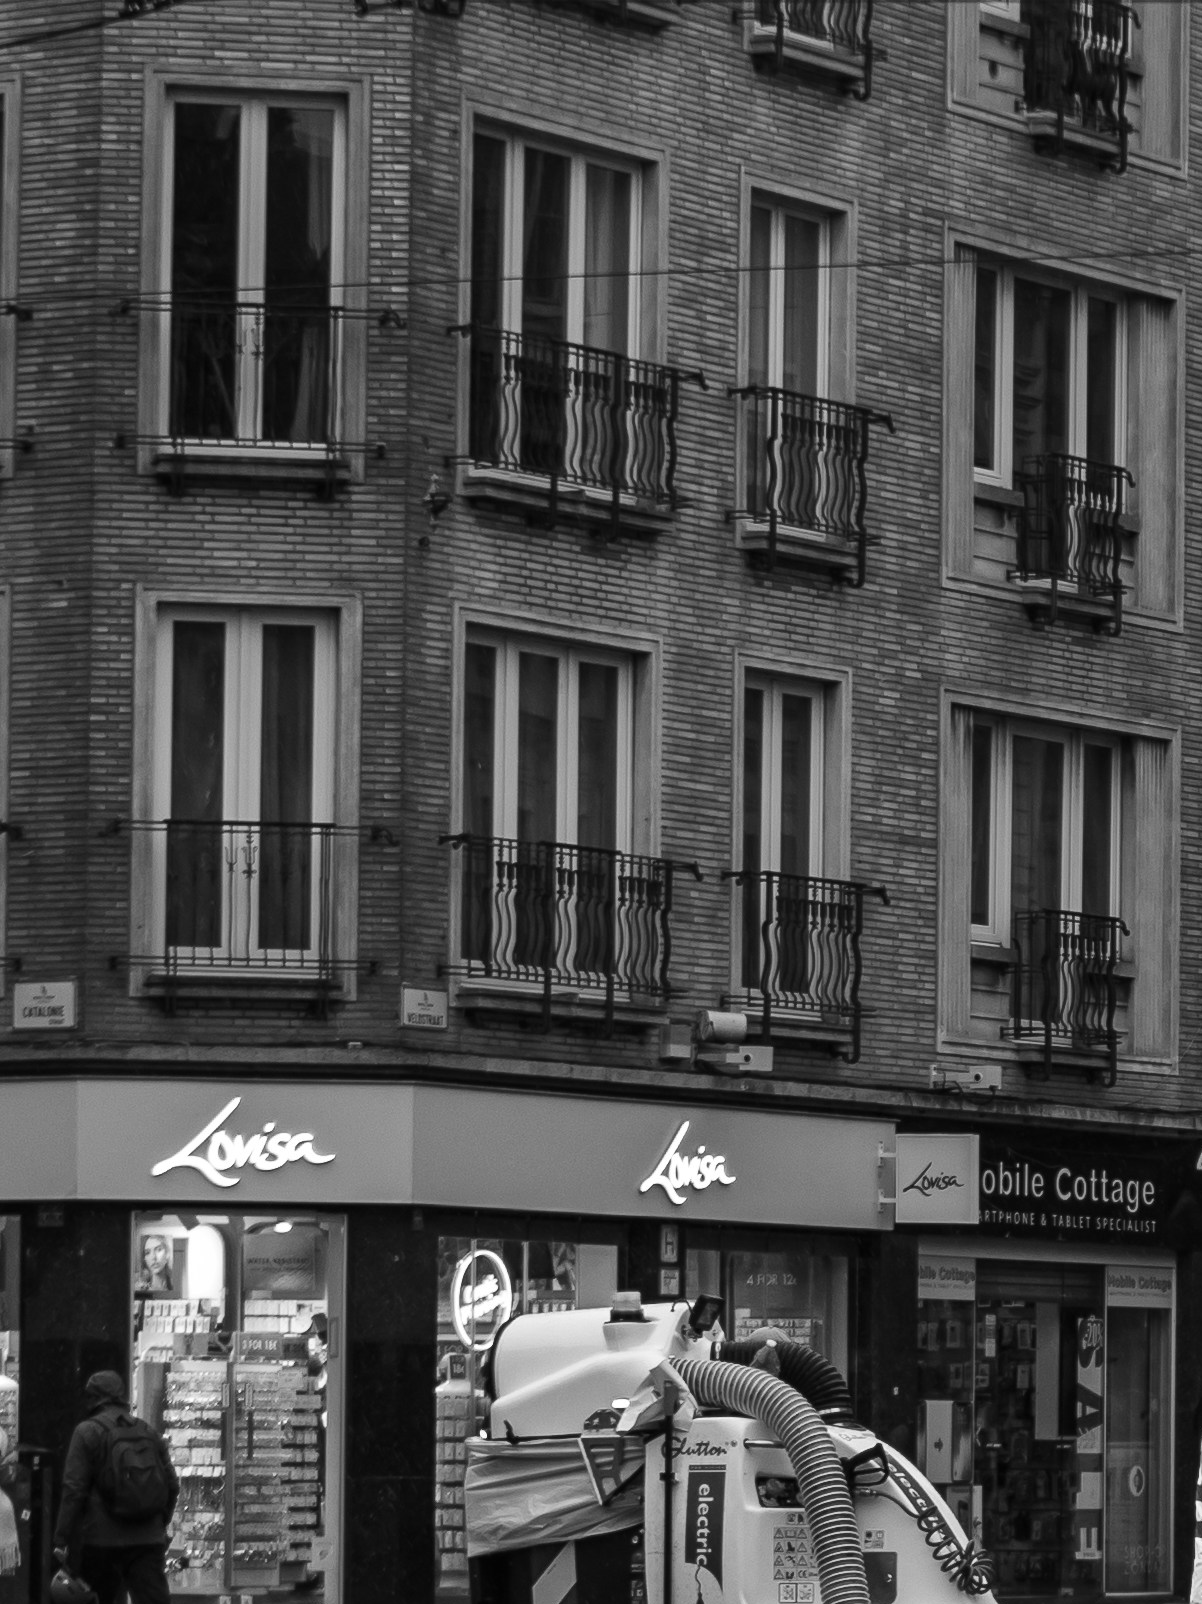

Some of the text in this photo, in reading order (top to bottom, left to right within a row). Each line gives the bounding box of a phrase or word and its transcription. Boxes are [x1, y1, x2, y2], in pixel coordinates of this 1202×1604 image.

[151, 1096, 335, 1188] Lovisa
[640, 1120, 737, 1205] Lovisa
[903, 1162, 965, 1197] Lovisa
[982, 1161, 1156, 1214] obile Cottage
[978, 1210, 1157, 1234] ARTPHONE & TABLET SPECIALIST
[661, 1436, 728, 1459] Glutton
[696, 1483, 715, 1567] electric
